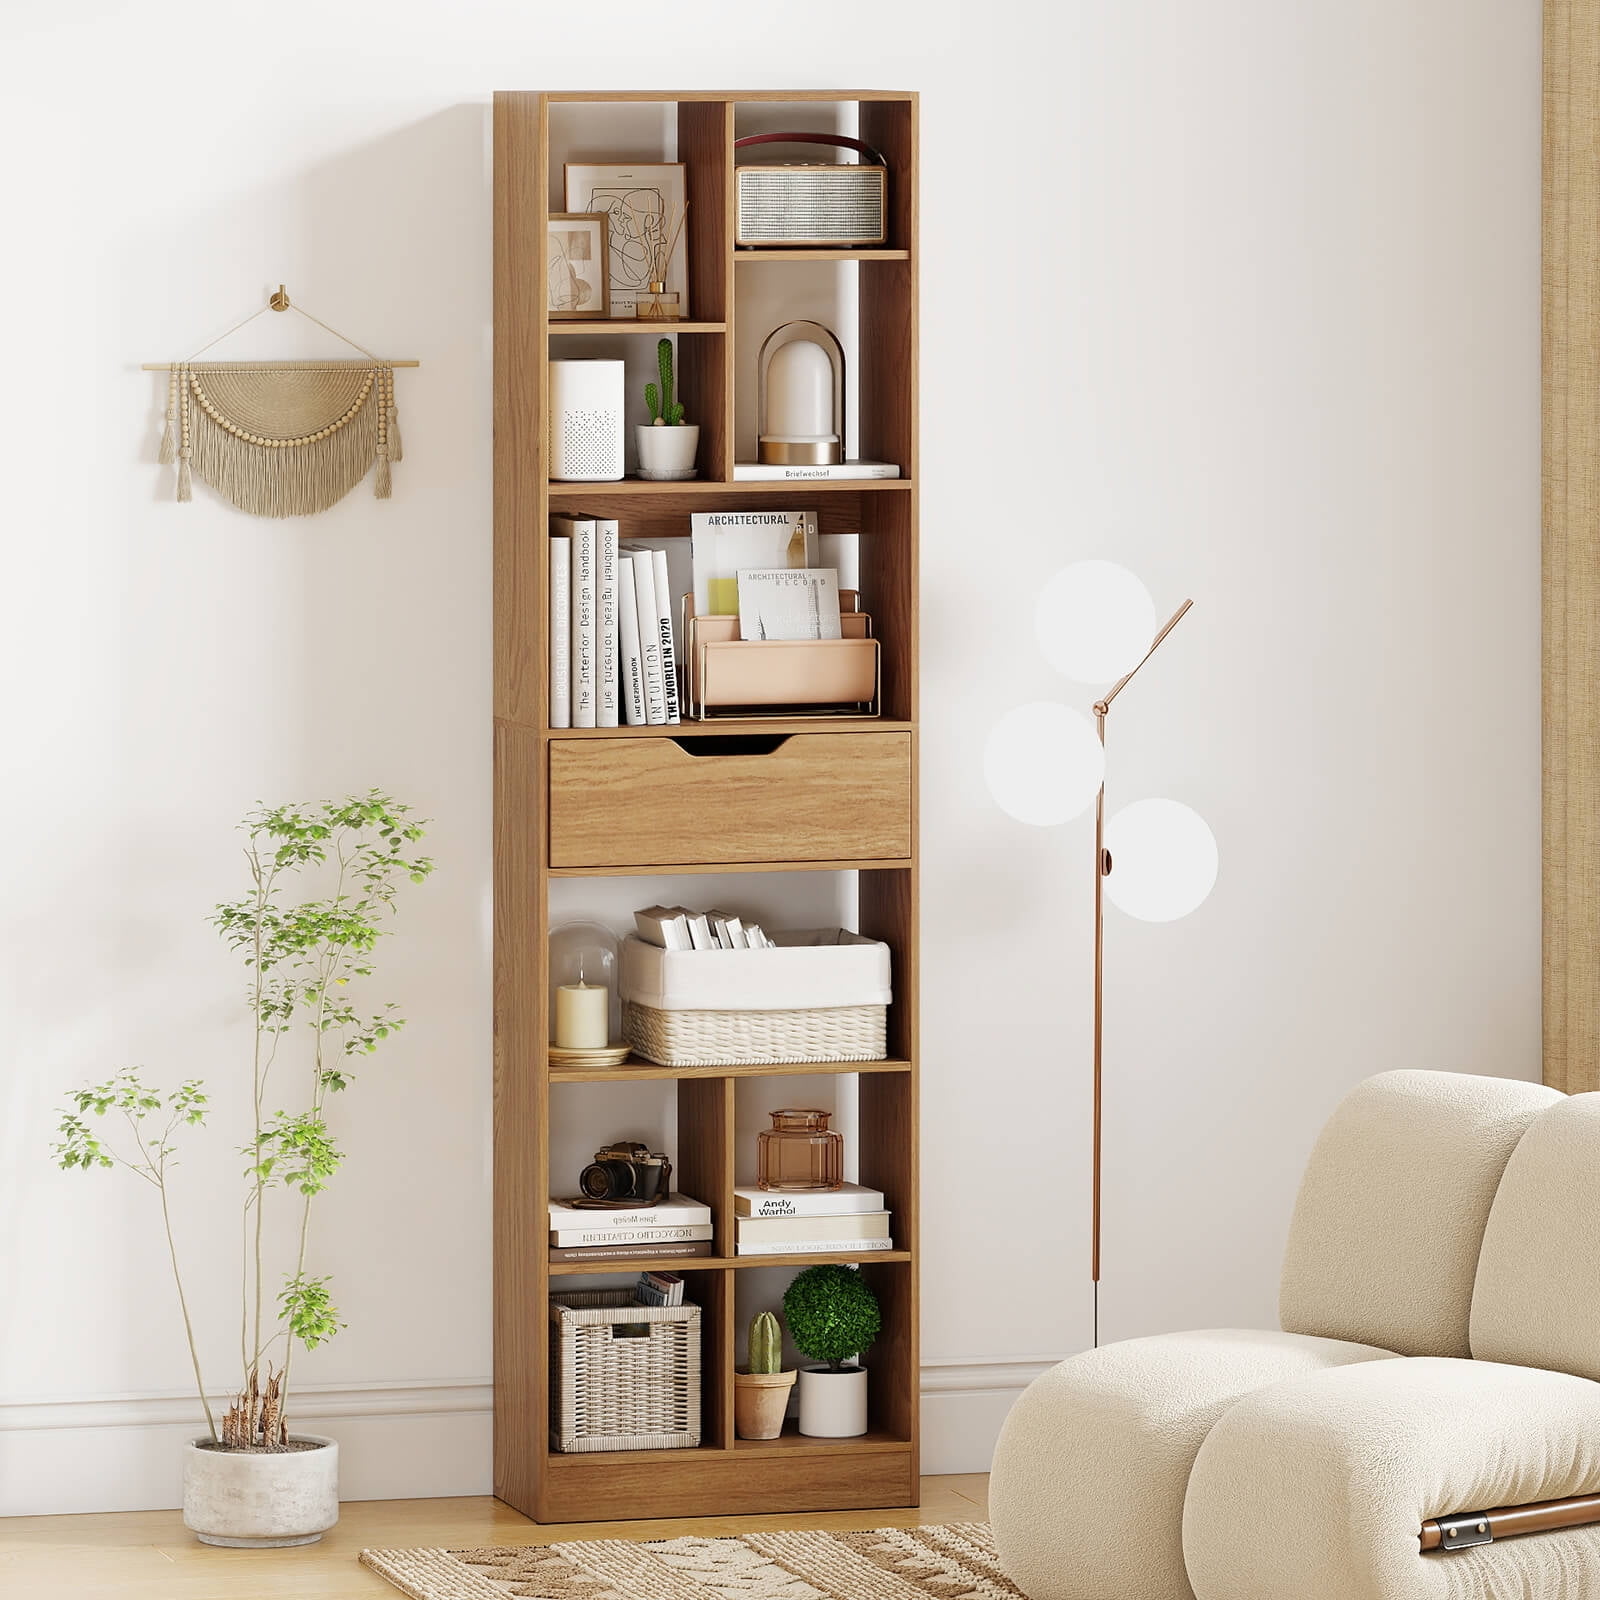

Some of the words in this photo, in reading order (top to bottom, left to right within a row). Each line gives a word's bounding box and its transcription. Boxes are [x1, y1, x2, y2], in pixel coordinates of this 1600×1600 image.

[785, 470, 830, 478] Briefwechsel
[708, 515, 789, 525] ARCHITECTURAL
[580, 529, 590, 581] Handbook
[580, 587, 591, 627] Design
[660, 618, 672, 645] 2020
[580, 633, 590, 684] Interior
[663, 648, 673, 658] IN
[646, 643, 662, 719] INTUITION
[664, 661, 676, 698] WORLD
[580, 690, 590, 711] The
[667, 700, 678, 720] THE
[759, 1207, 796, 1216] Warhol
[763, 1199, 792, 1208] Andy
